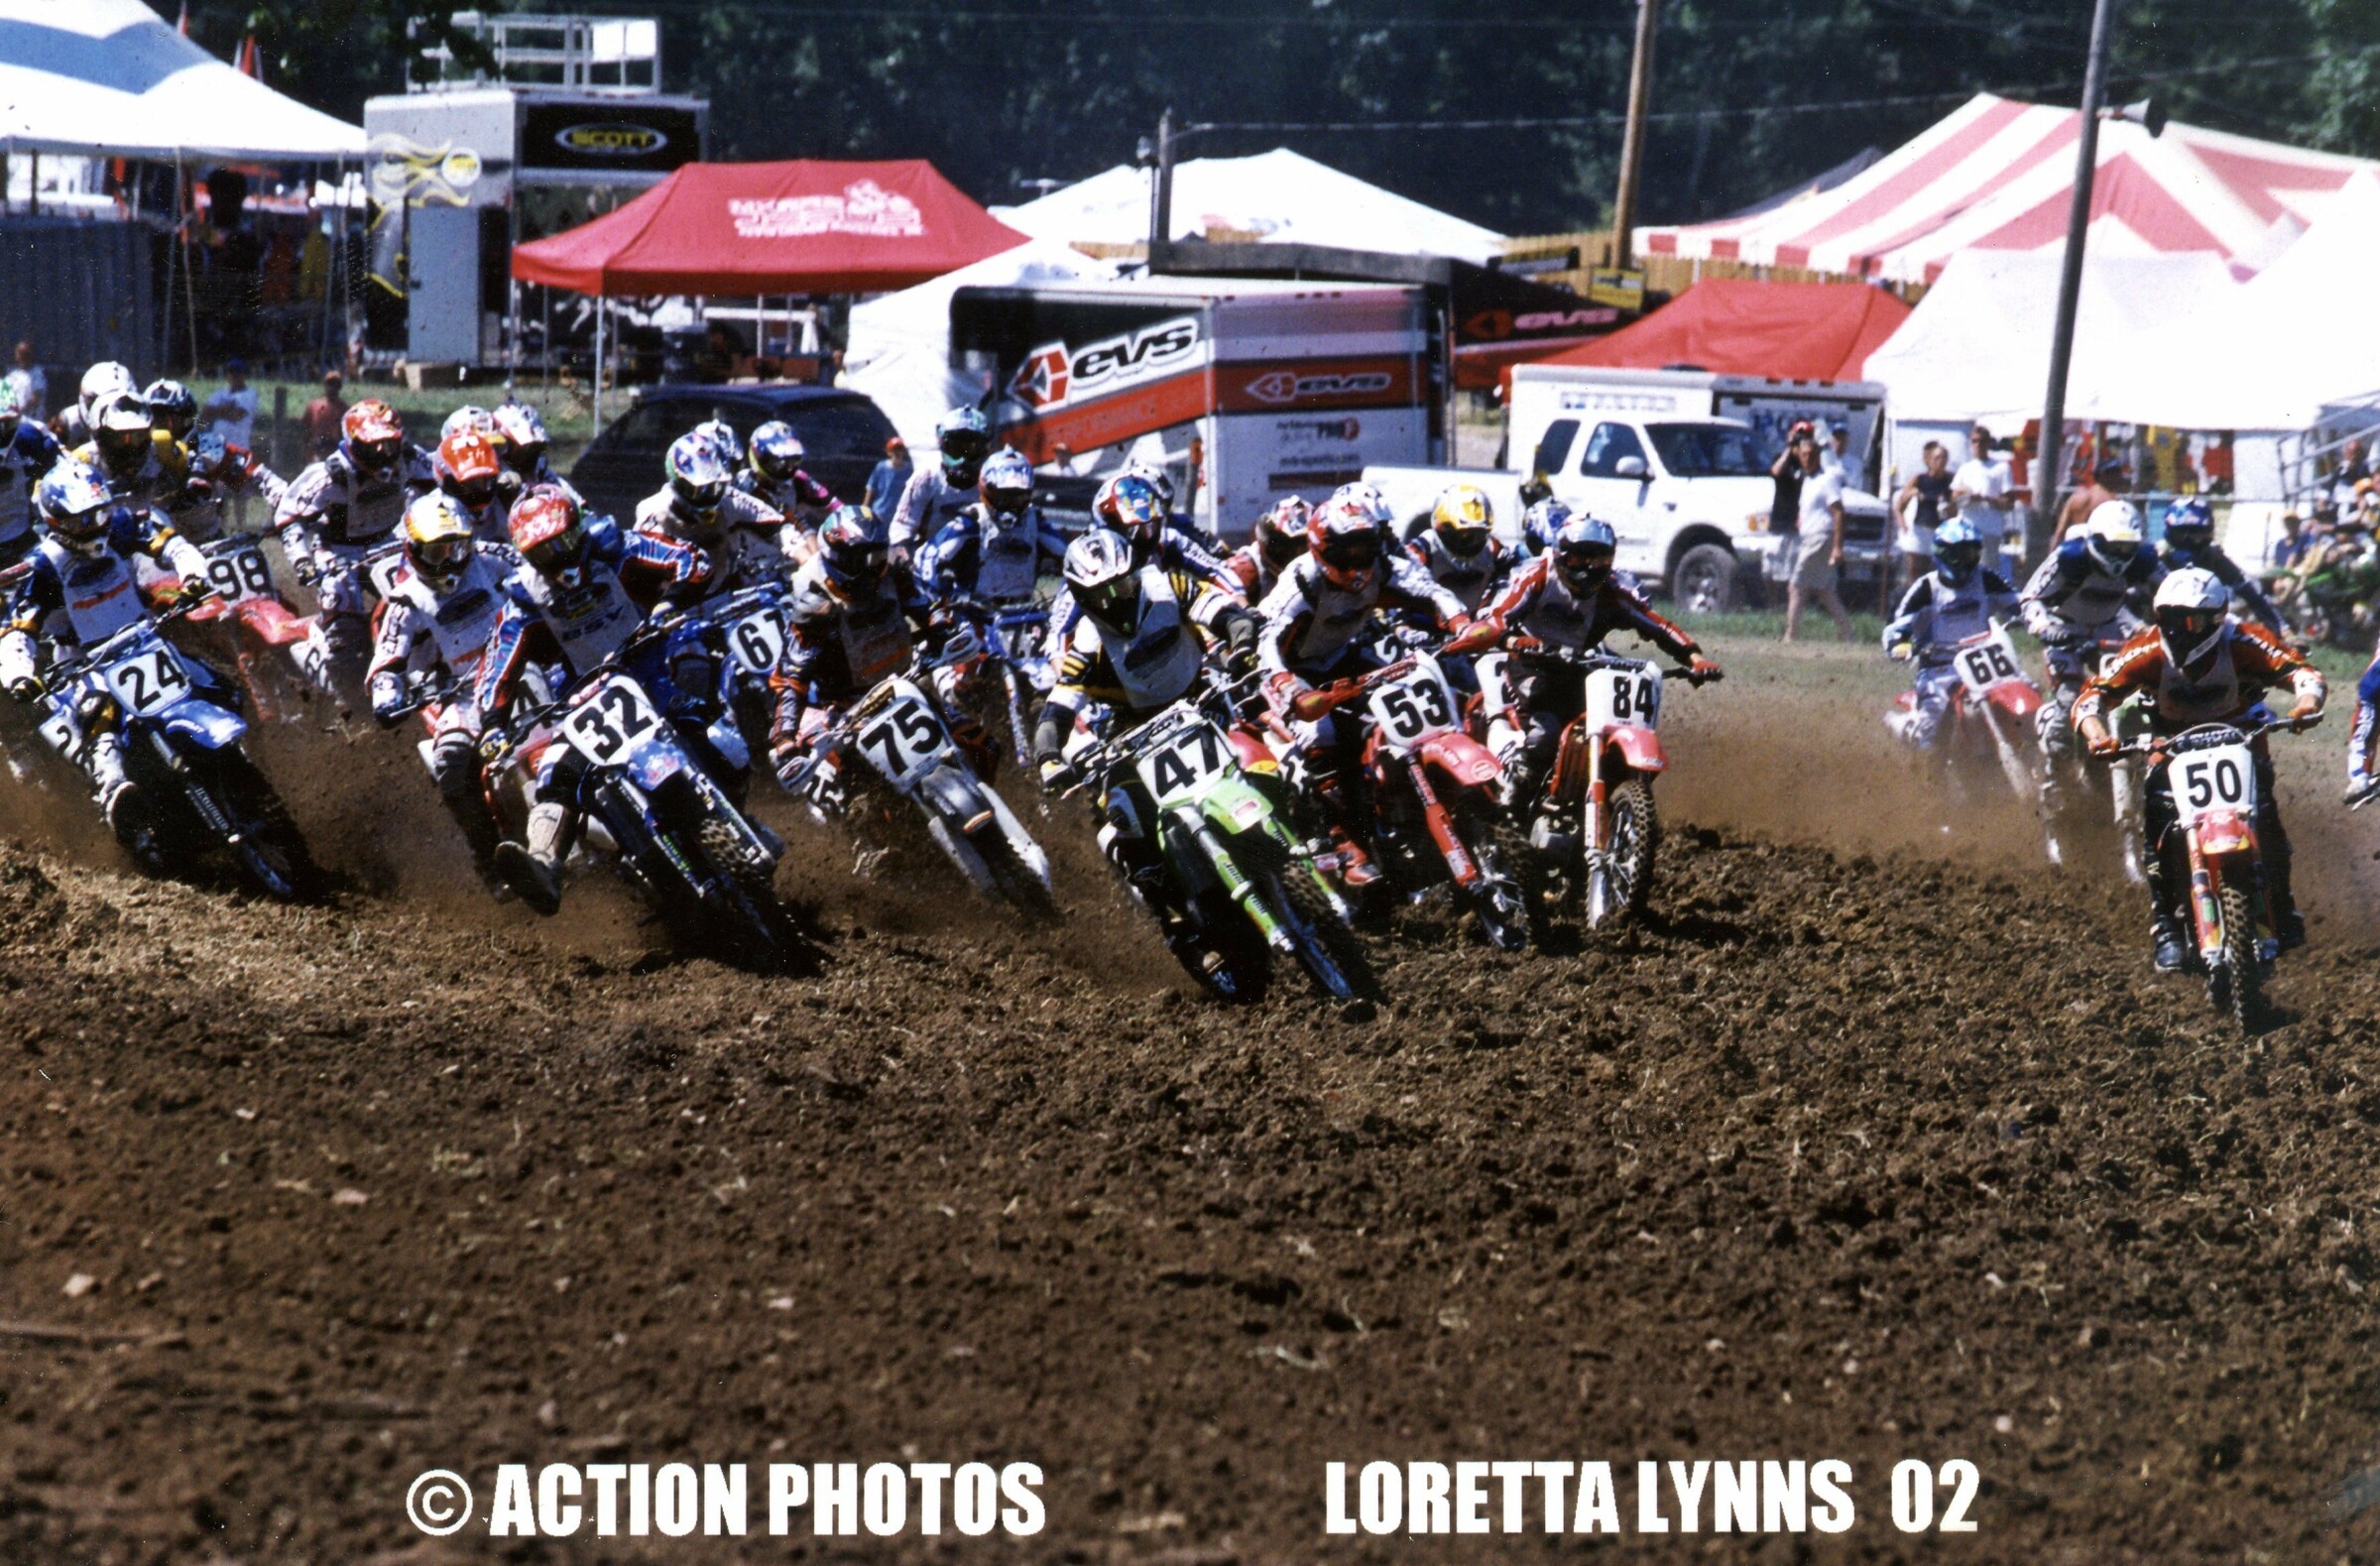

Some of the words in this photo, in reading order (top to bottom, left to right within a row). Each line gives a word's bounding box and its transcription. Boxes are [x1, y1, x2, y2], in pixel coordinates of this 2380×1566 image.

[208, 550, 273, 601] 98
[737, 609, 787, 669] 67
[1964, 644, 2015, 685] 66
[118, 650, 185, 711] 24
[1381, 678, 1451, 738] 53
[1613, 675, 1654, 722] 84
[573, 684, 654, 762] 32
[861, 698, 943, 778] 75
[1153, 721, 1221, 798] 47
[2186, 758, 2243, 808] 50
